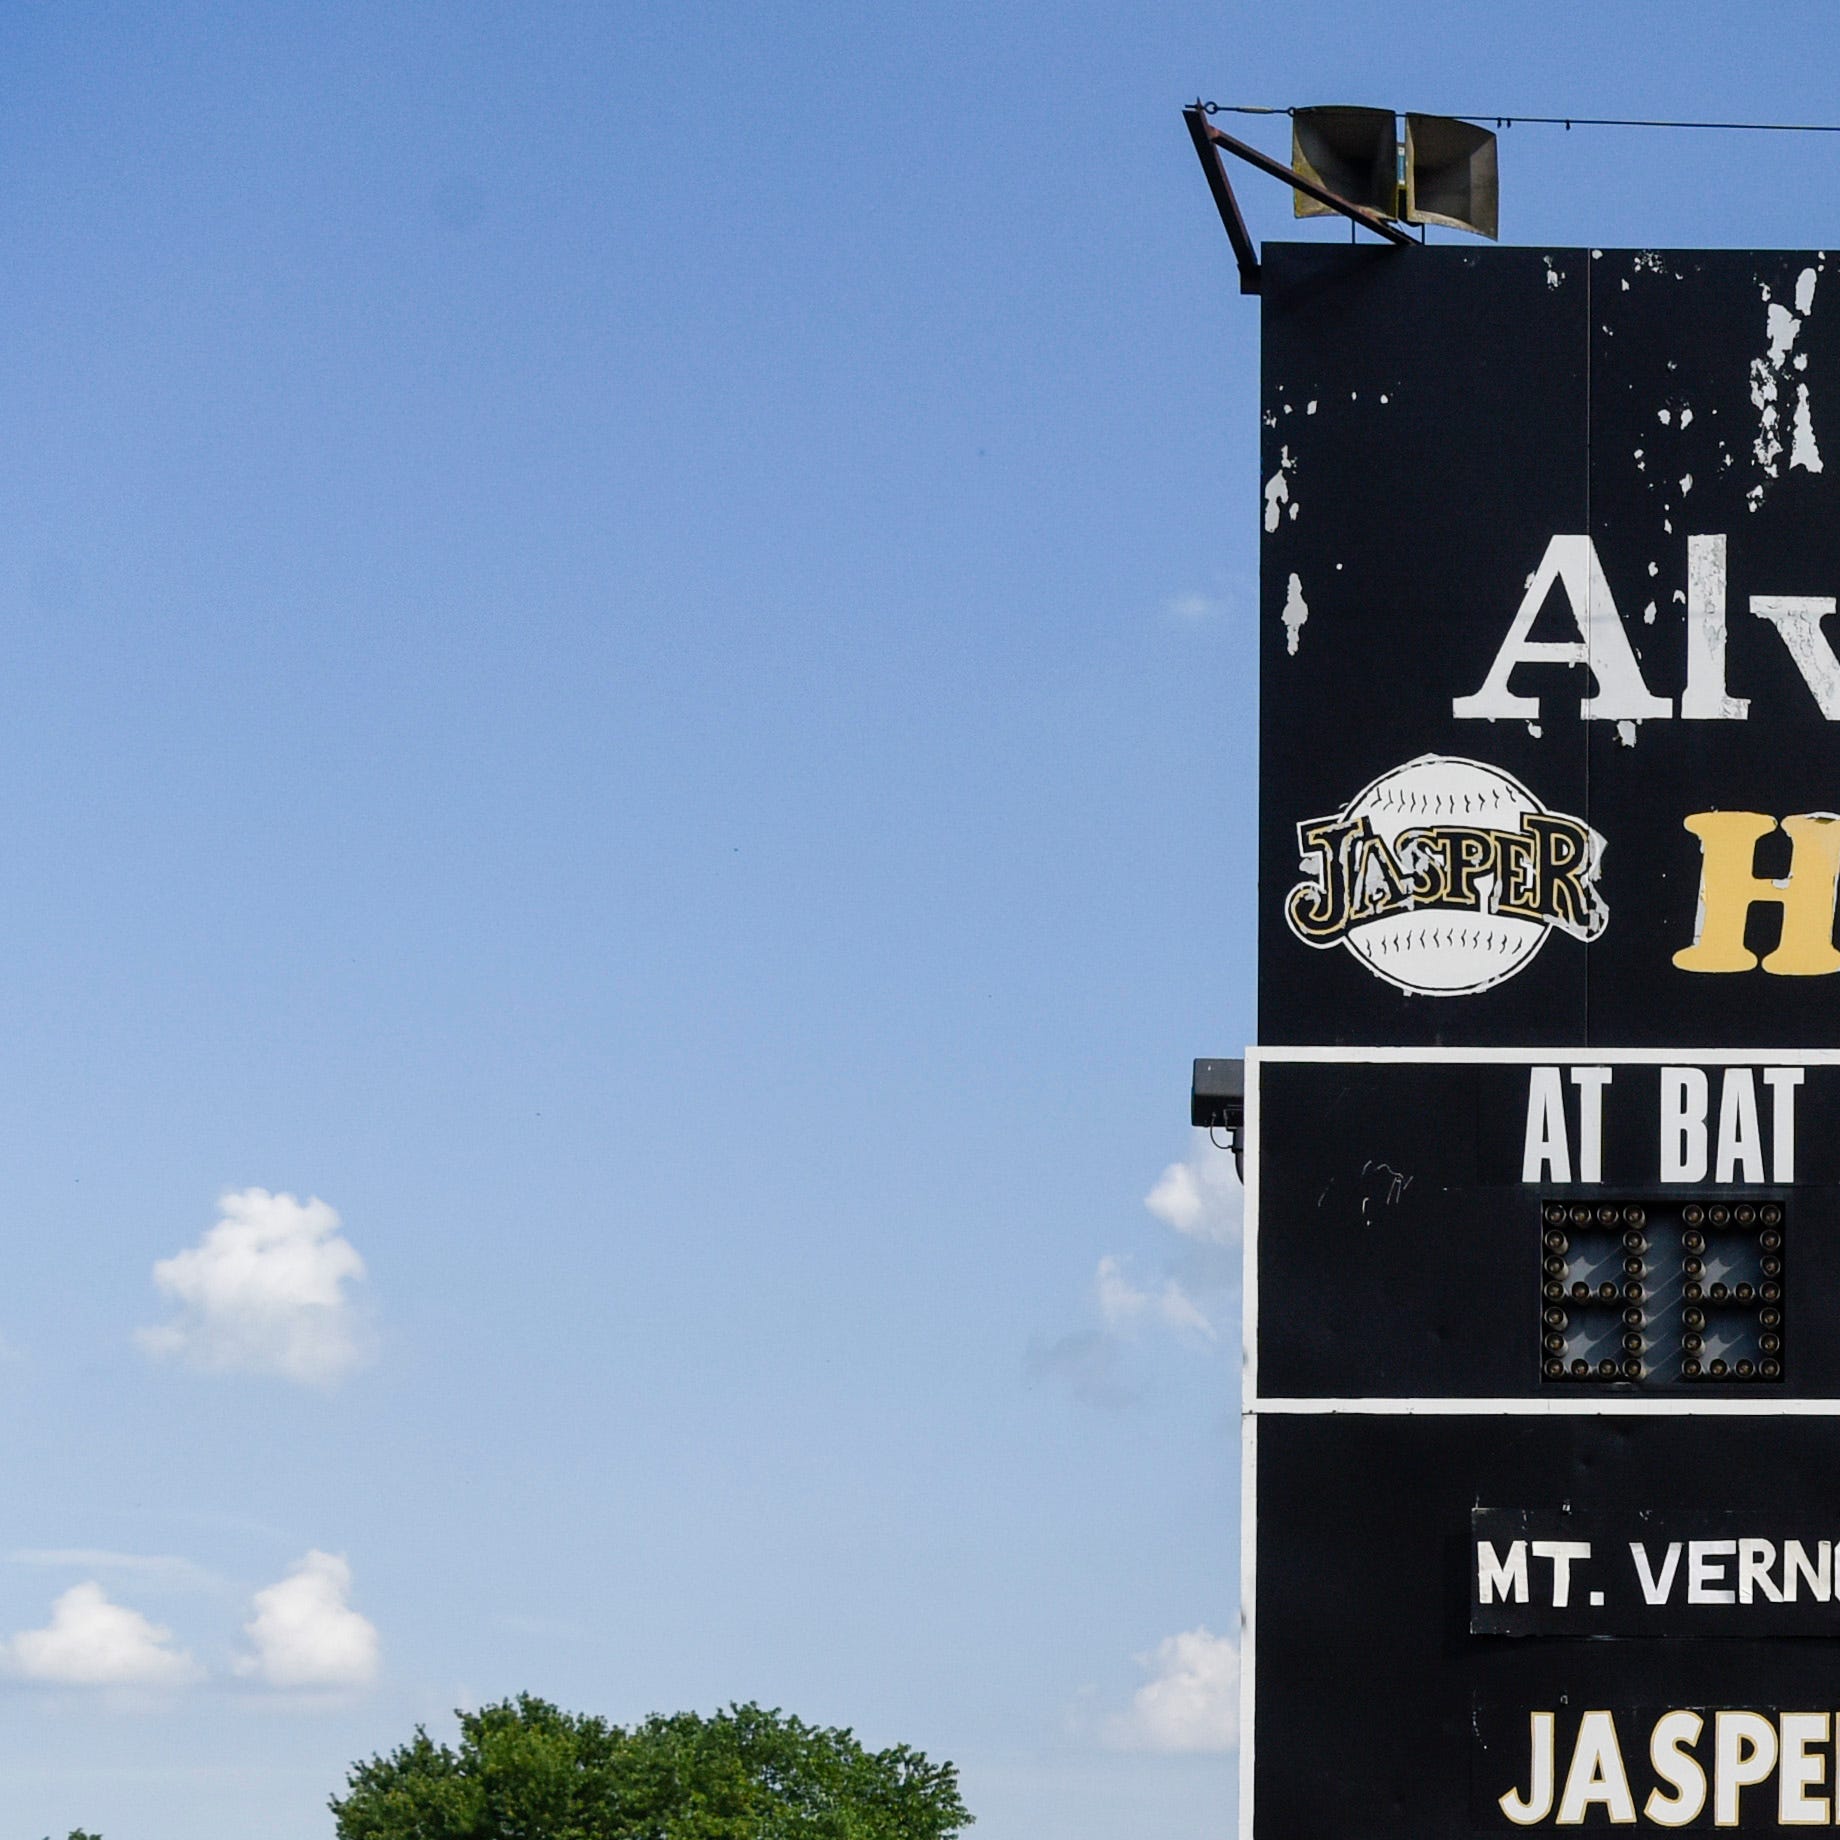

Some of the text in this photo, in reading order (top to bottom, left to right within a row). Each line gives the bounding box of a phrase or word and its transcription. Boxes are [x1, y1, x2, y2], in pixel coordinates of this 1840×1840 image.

[1296, 812, 1602, 932] JASPER
[1521, 1066, 1806, 1184] AT BAT
[1476, 1538, 1606, 1607] MT.
